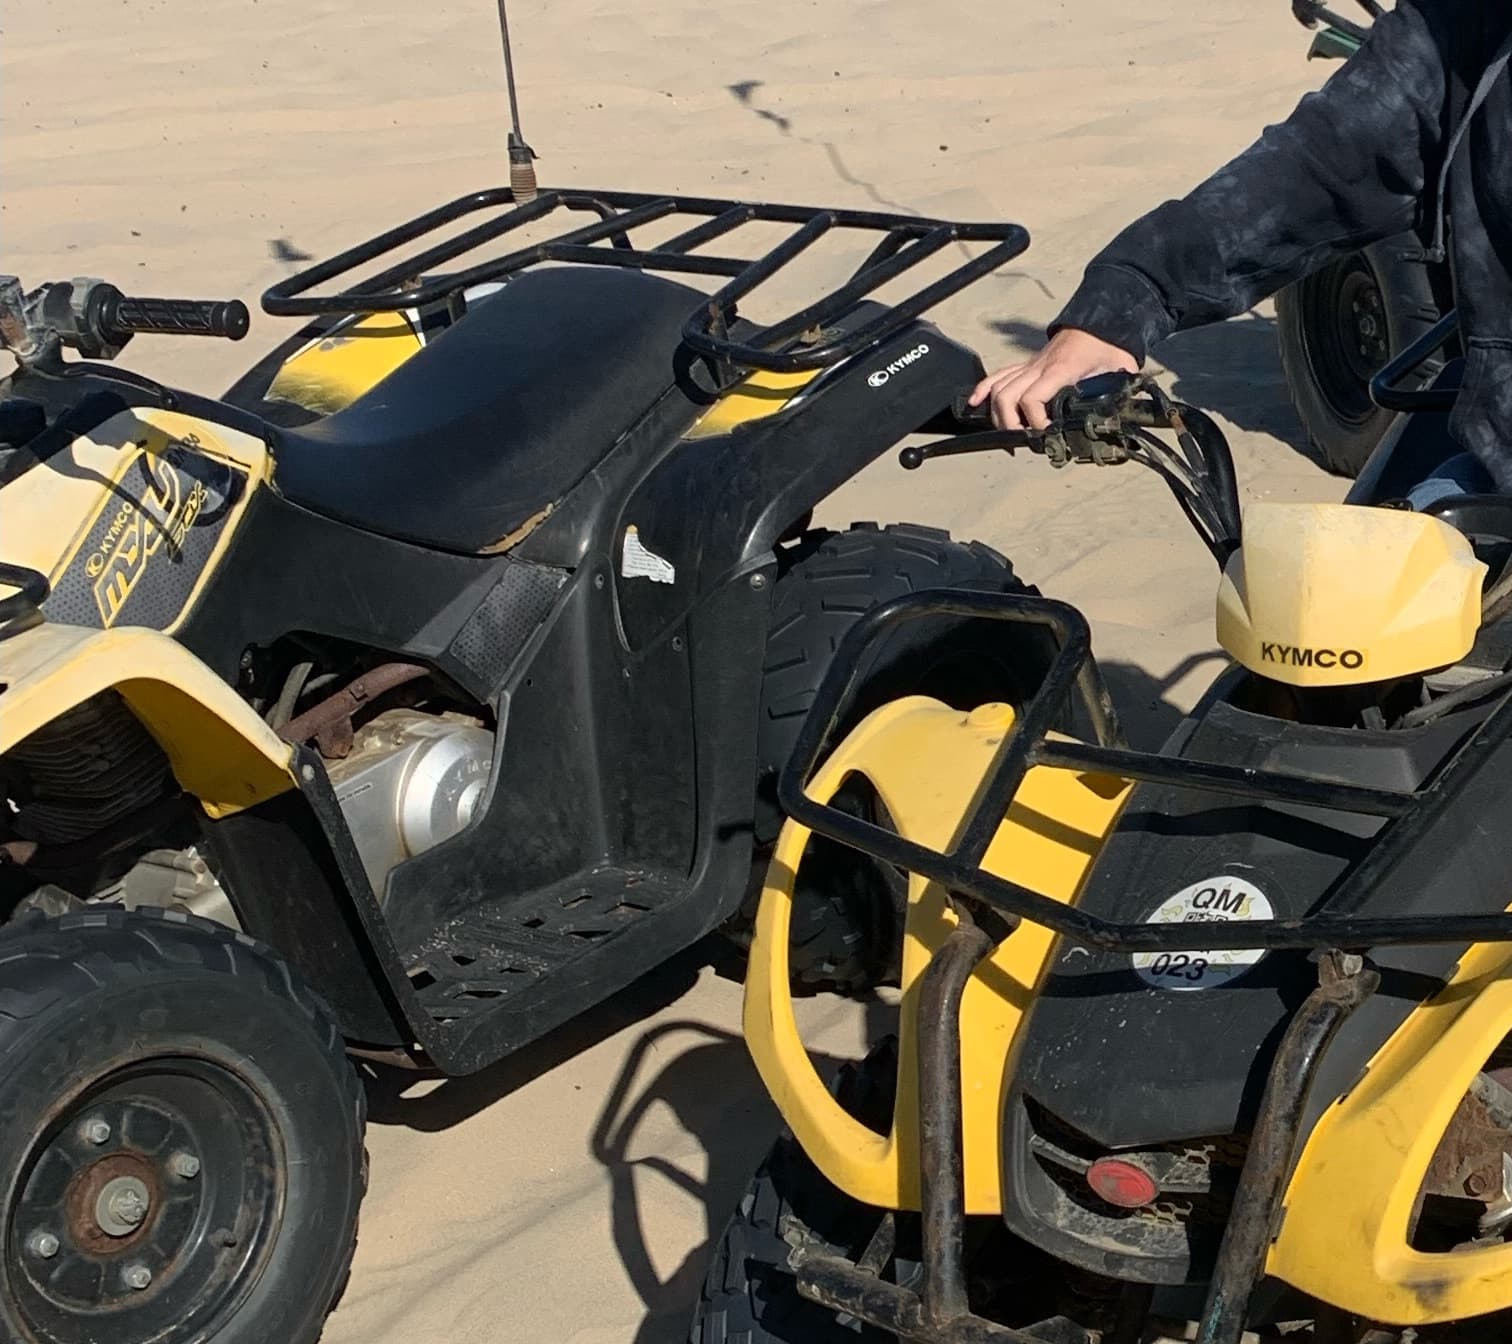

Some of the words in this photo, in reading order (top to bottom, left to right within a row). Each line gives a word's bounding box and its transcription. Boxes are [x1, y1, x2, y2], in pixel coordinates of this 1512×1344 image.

[886, 344, 929, 375] KYMCO
[100, 502, 134, 554] KYMCO
[1261, 641, 1364, 670] KYMCO
[1192, 887, 1247, 914] QM
[1151, 953, 1209, 981] 023
